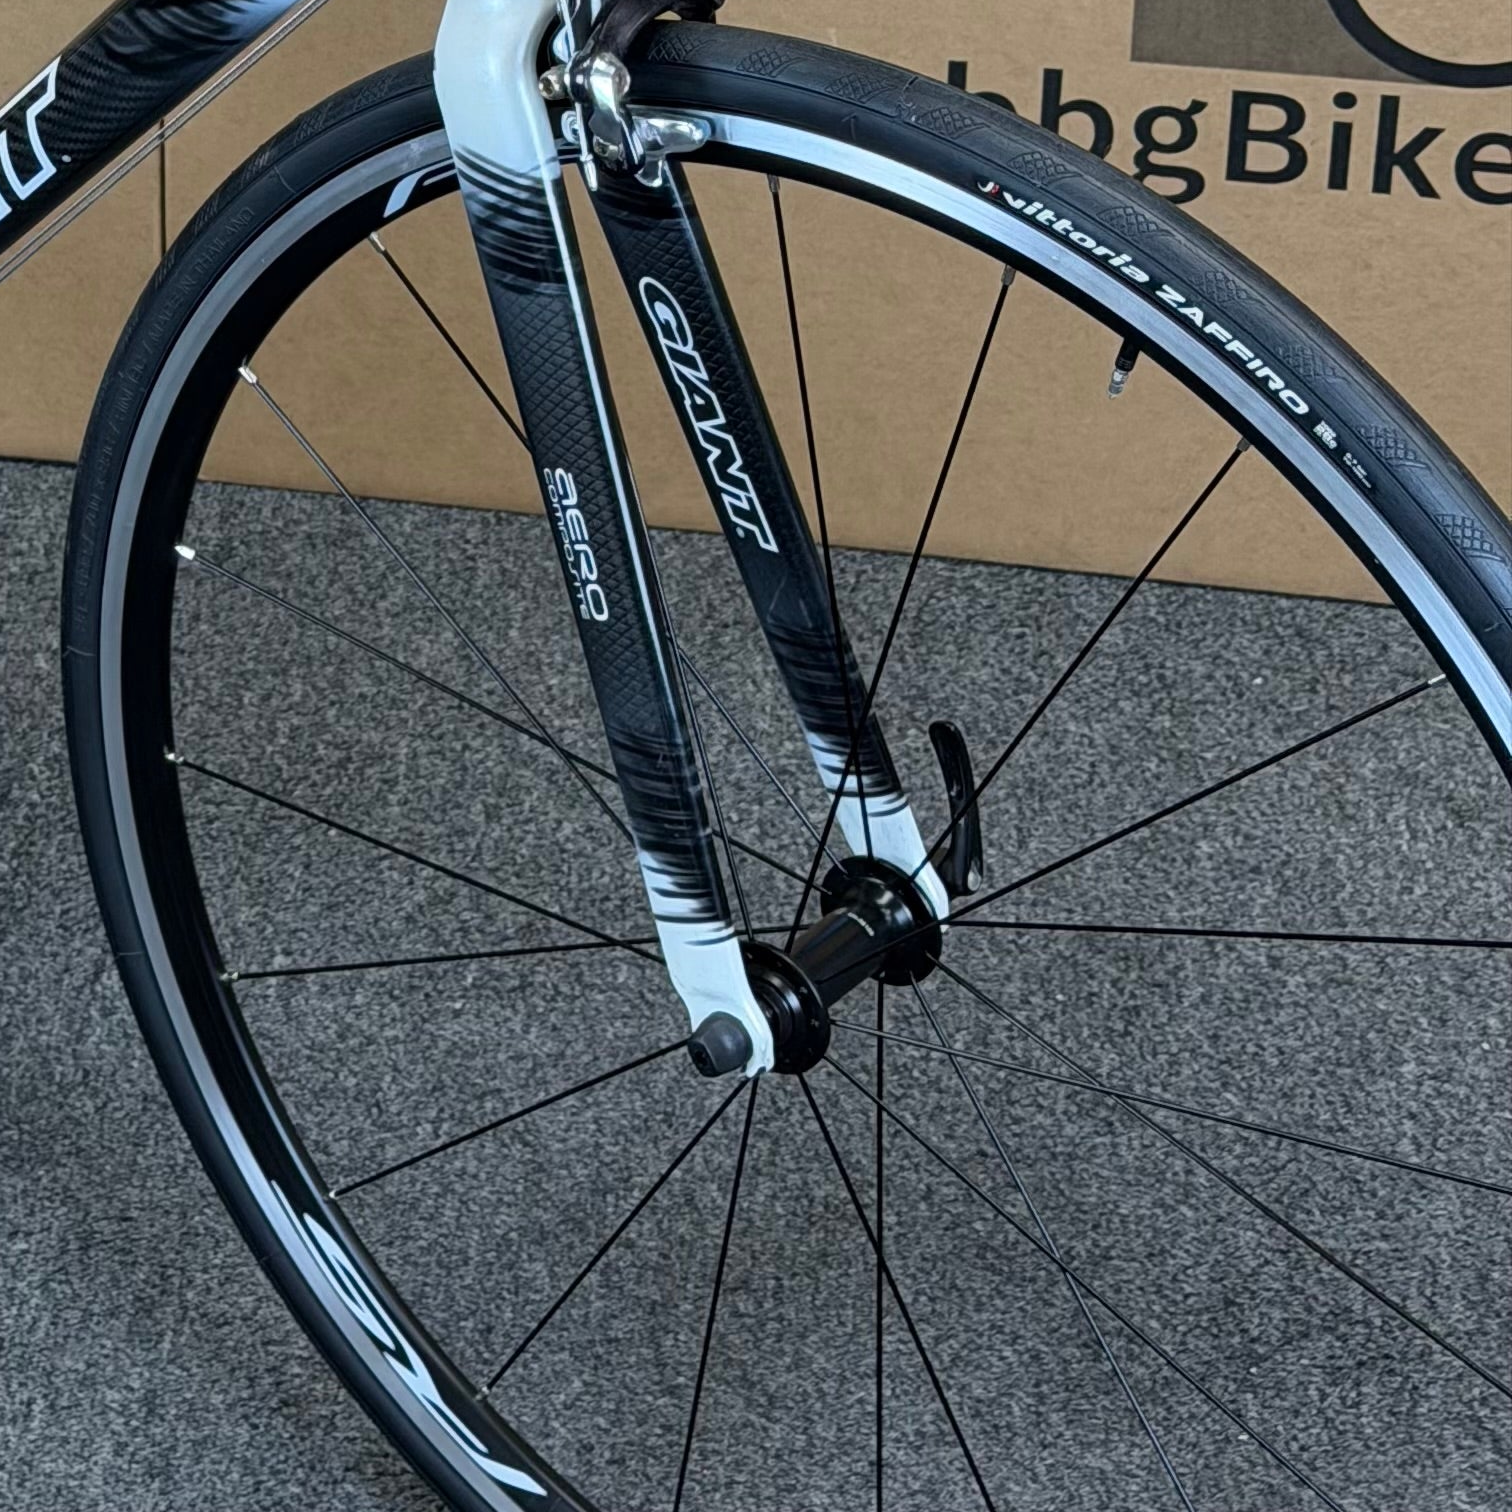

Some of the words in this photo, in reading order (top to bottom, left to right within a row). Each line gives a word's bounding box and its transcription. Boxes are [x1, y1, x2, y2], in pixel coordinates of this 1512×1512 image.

[638, 276, 779, 553] GIANT
[1002, 190, 1150, 284] vittoria
[1154, 283, 1310, 416] ZAFFIRO
